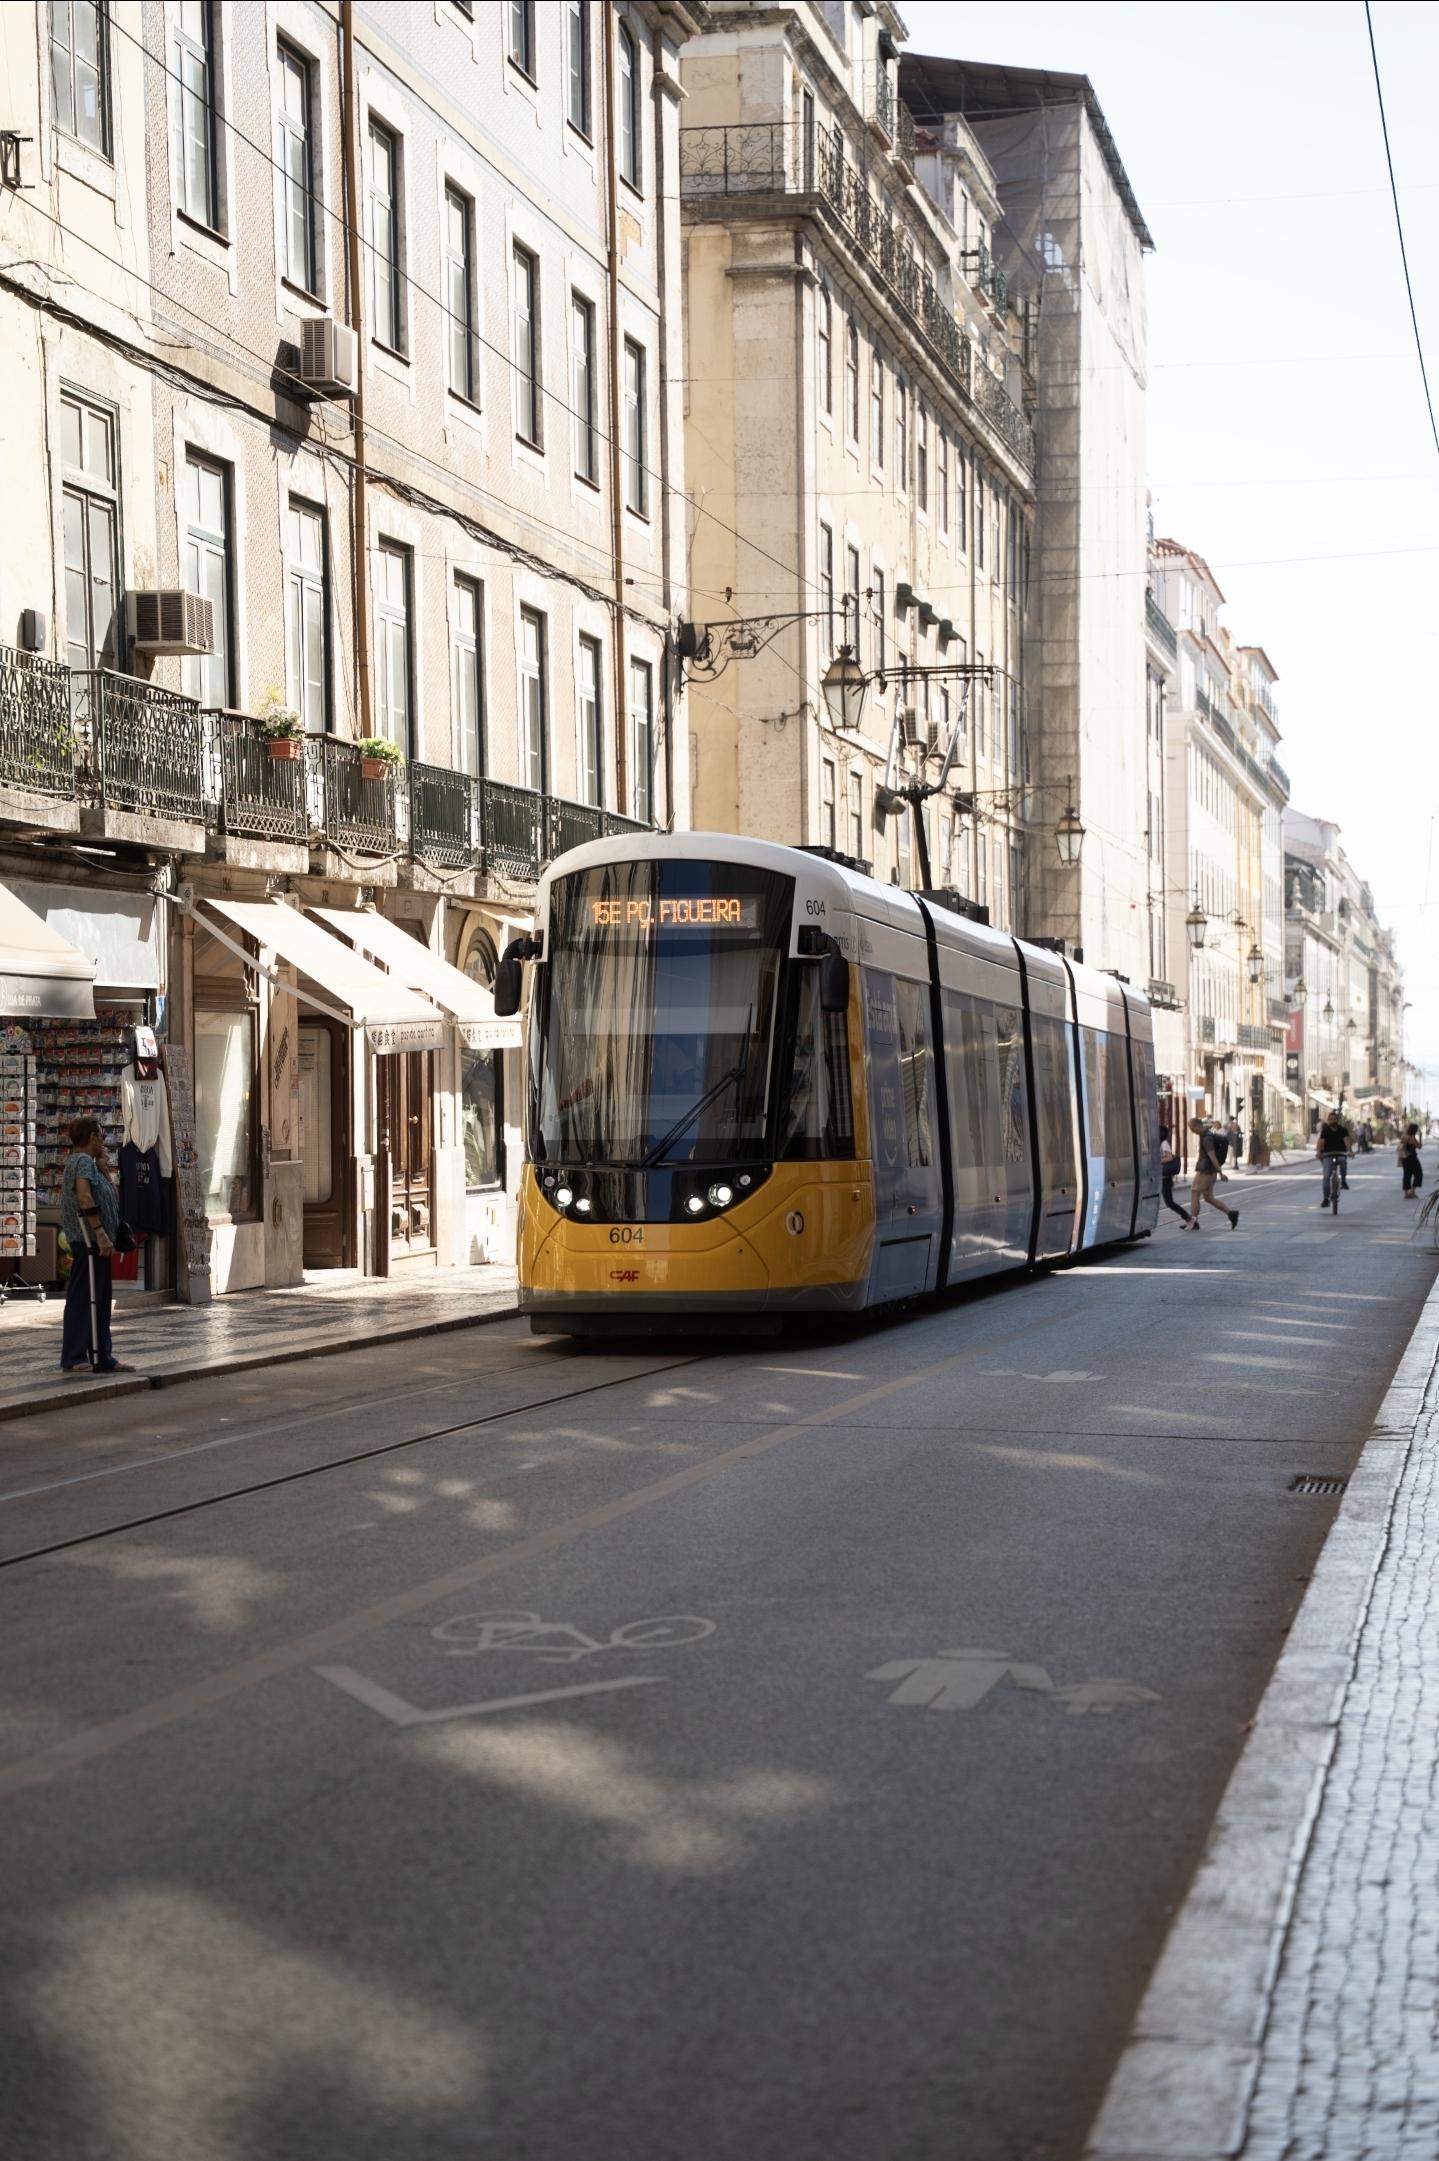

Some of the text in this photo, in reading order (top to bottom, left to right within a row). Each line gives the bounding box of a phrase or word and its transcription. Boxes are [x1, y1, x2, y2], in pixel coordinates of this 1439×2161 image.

[592, 899, 741, 928] 15E PÇ. FIGUEIRA
[806, 900, 826, 916] 604
[610, 1226, 645, 1244] 604
[610, 1270, 640, 1282] CAF
